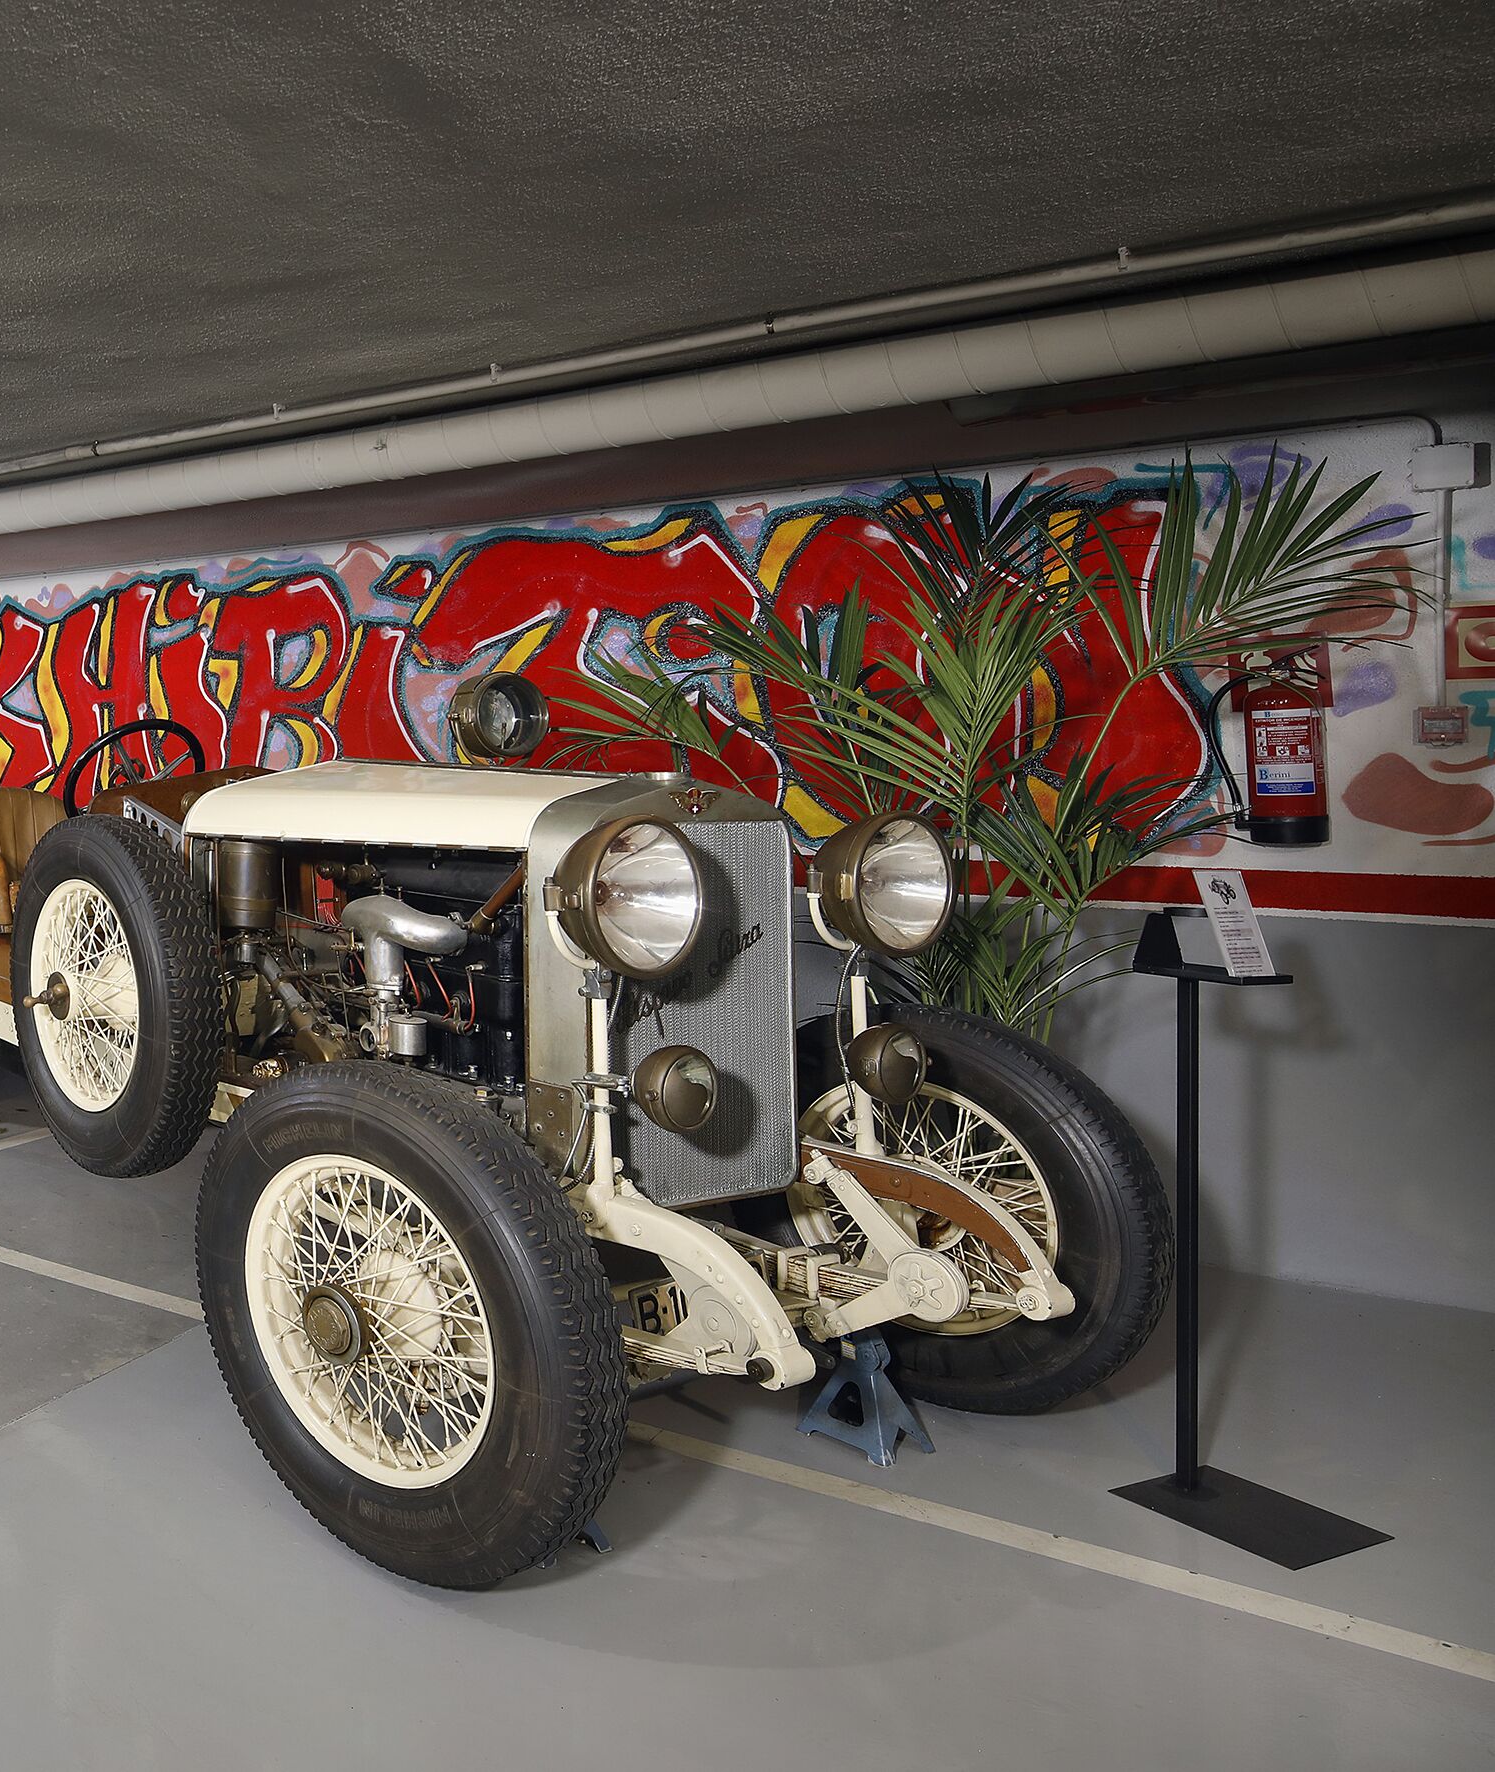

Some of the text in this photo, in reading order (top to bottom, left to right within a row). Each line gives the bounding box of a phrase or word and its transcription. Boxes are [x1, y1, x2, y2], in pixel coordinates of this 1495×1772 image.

[1259, 769, 1291, 780] Berini
[262, 1120, 346, 1154] MICHELIN
[358, 1498, 452, 1529] MICHELIN
